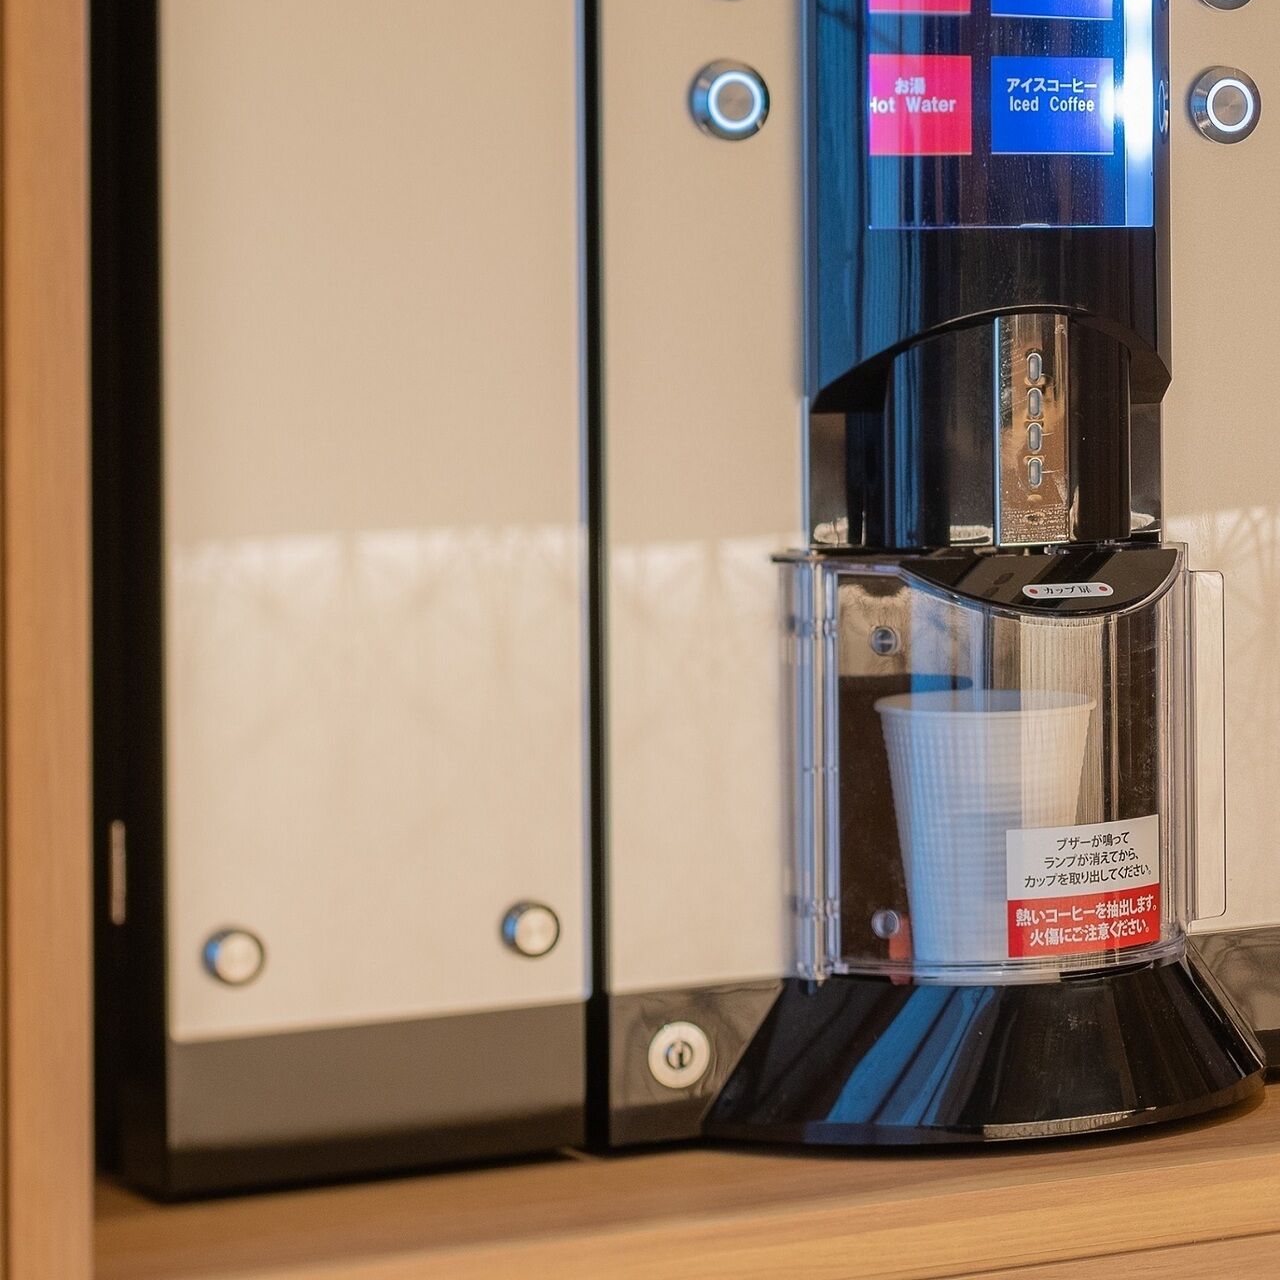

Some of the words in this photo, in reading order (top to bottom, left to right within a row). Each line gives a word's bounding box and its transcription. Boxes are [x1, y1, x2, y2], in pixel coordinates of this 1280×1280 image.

[1007, 78, 1097, 93] アイスコーヒー
[905, 96, 957, 113] Water
[1010, 97, 1038, 112] Iced
[1050, 96, 1094, 112] Coffee
[1056, 831, 1130, 851] ブザーが鳴って
[1044, 847, 1139, 869] ランプが消えてから、
[1024, 864, 1152, 888] カップを取り出してください。
[1015, 894, 1158, 927] 熱いコーヒーを抽出します。
[1029, 919, 1150, 947] 火傷にご注意ください。
